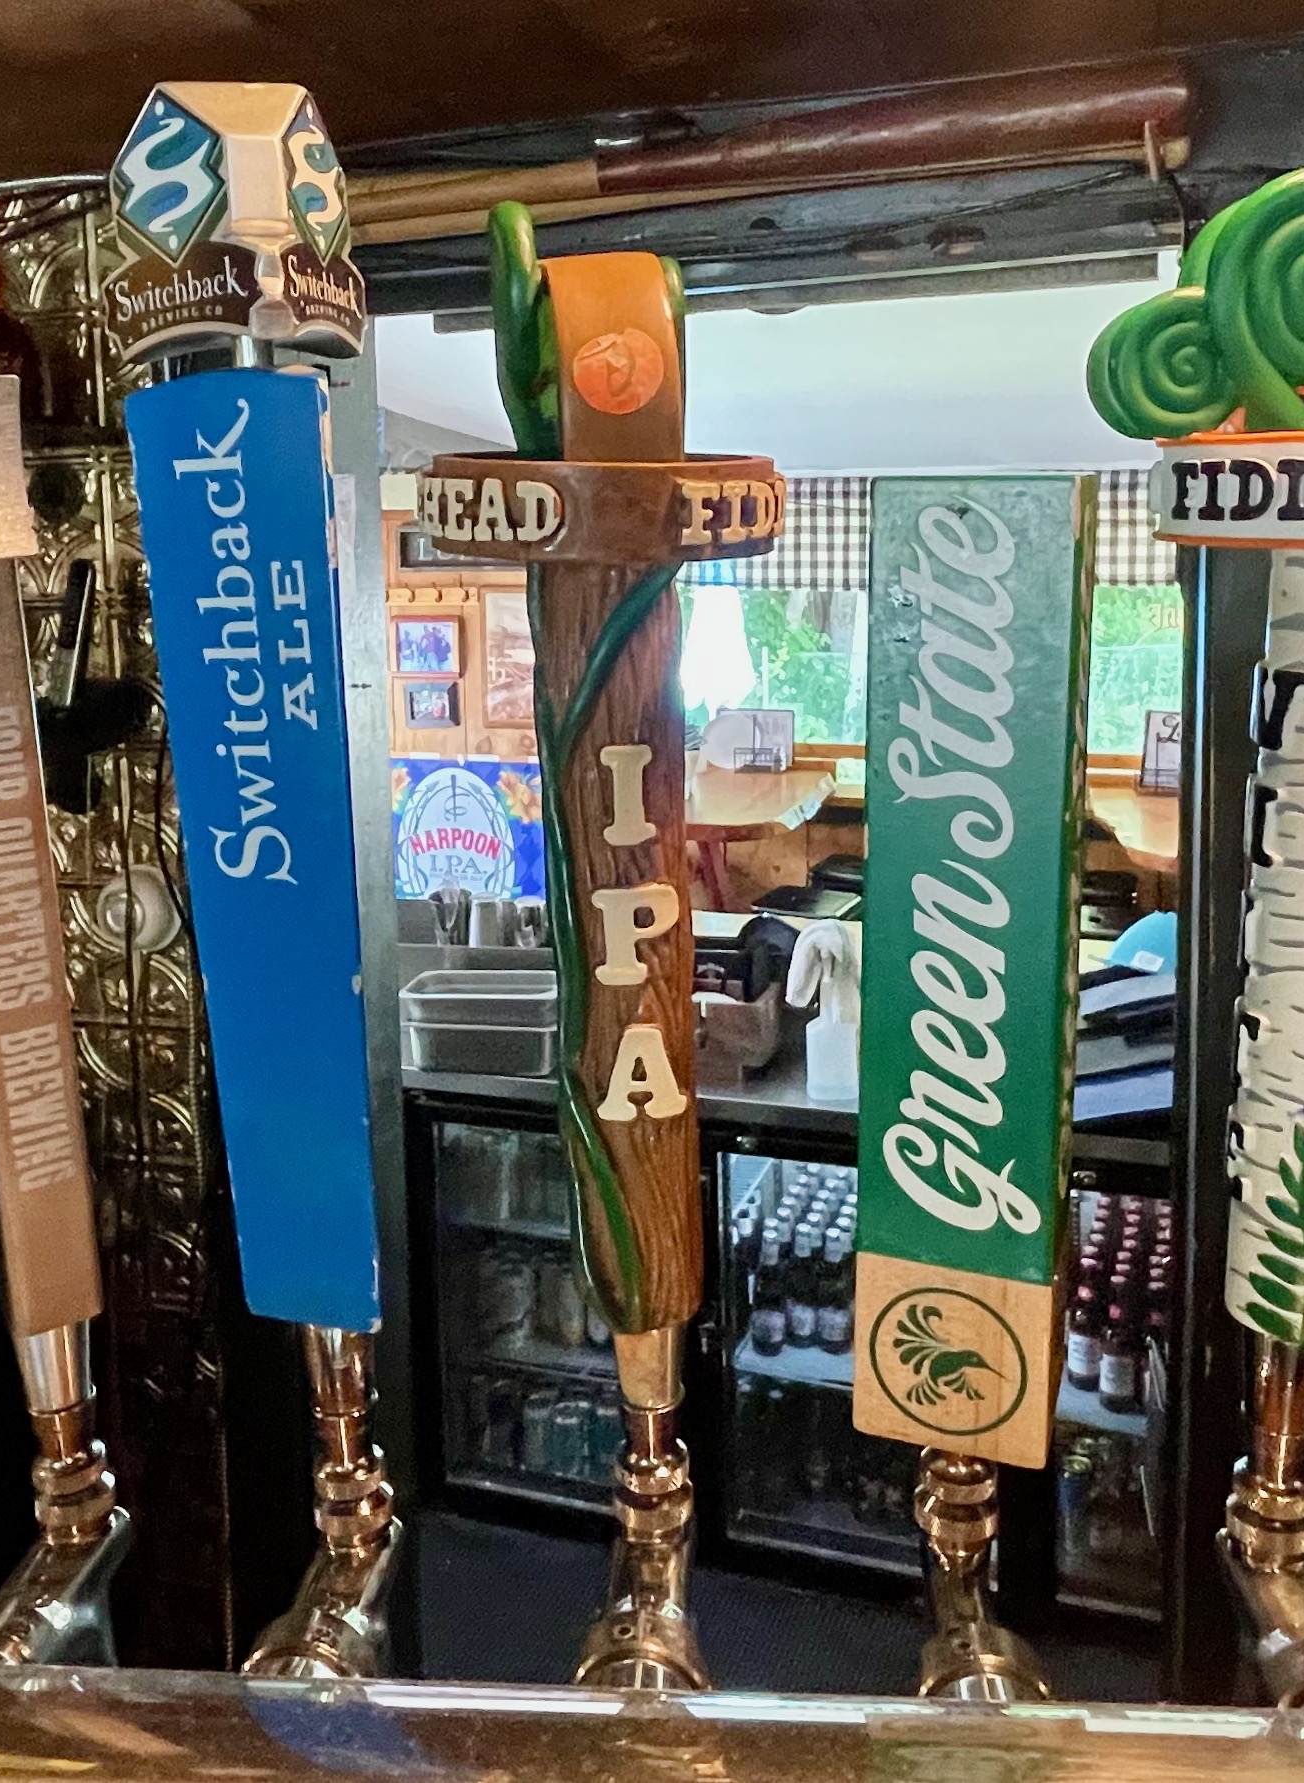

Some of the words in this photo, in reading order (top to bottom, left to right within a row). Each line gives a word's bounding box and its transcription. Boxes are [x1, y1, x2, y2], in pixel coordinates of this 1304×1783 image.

[113, 255, 249, 322] Switchback
[287, 254, 363, 319] Switchback
[419, 477, 564, 541] HEAD
[174, 399, 298, 885] Switchback
[270, 559, 319, 731] ALE
[887, 494, 1016, 860] State
[408, 827, 502, 861] HARPOON
[428, 854, 488, 876] I.P.A.
[881, 859, 1042, 1234] Green
